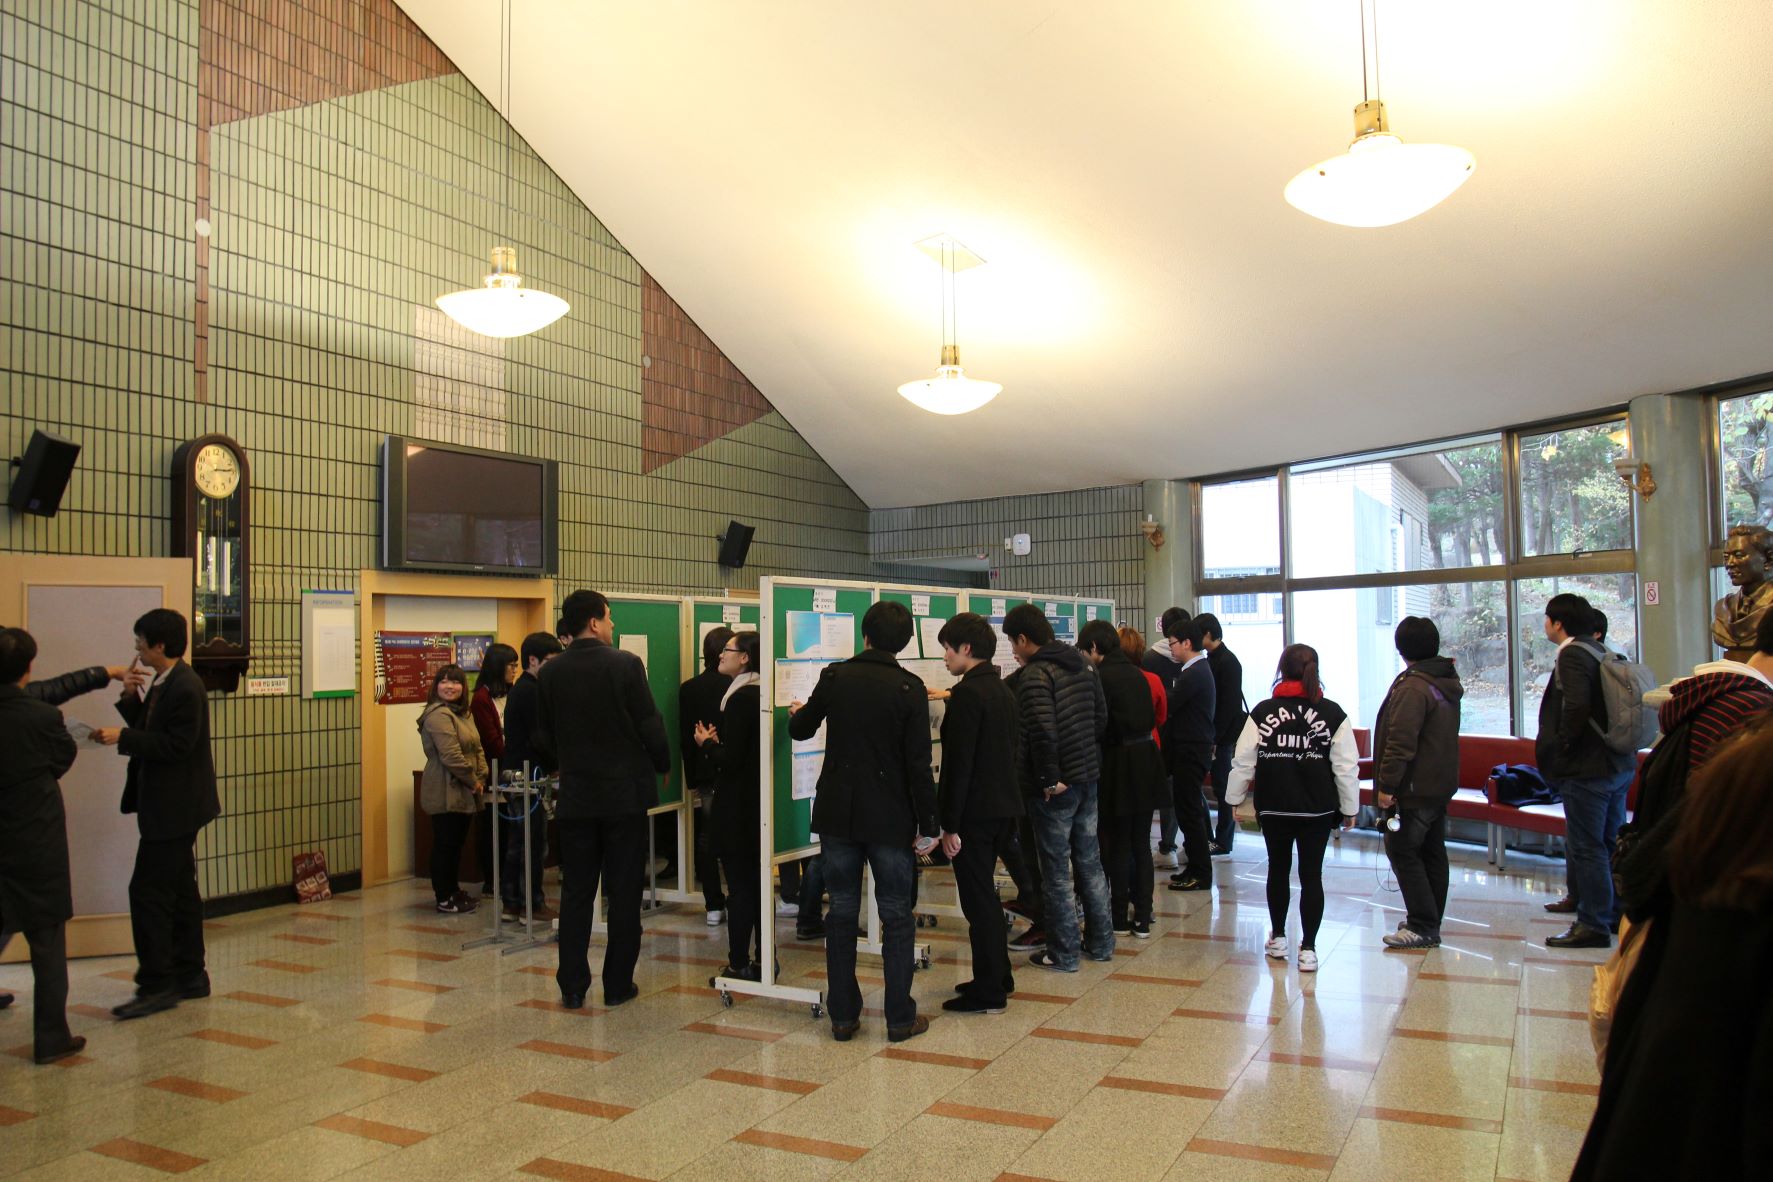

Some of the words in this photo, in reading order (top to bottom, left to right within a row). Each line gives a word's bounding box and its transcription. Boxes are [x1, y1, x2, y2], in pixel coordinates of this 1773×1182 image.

[212, 448, 220, 456] 12
[1277, 734, 1312, 750] UNIV.
[1296, 752, 1304, 760] of
